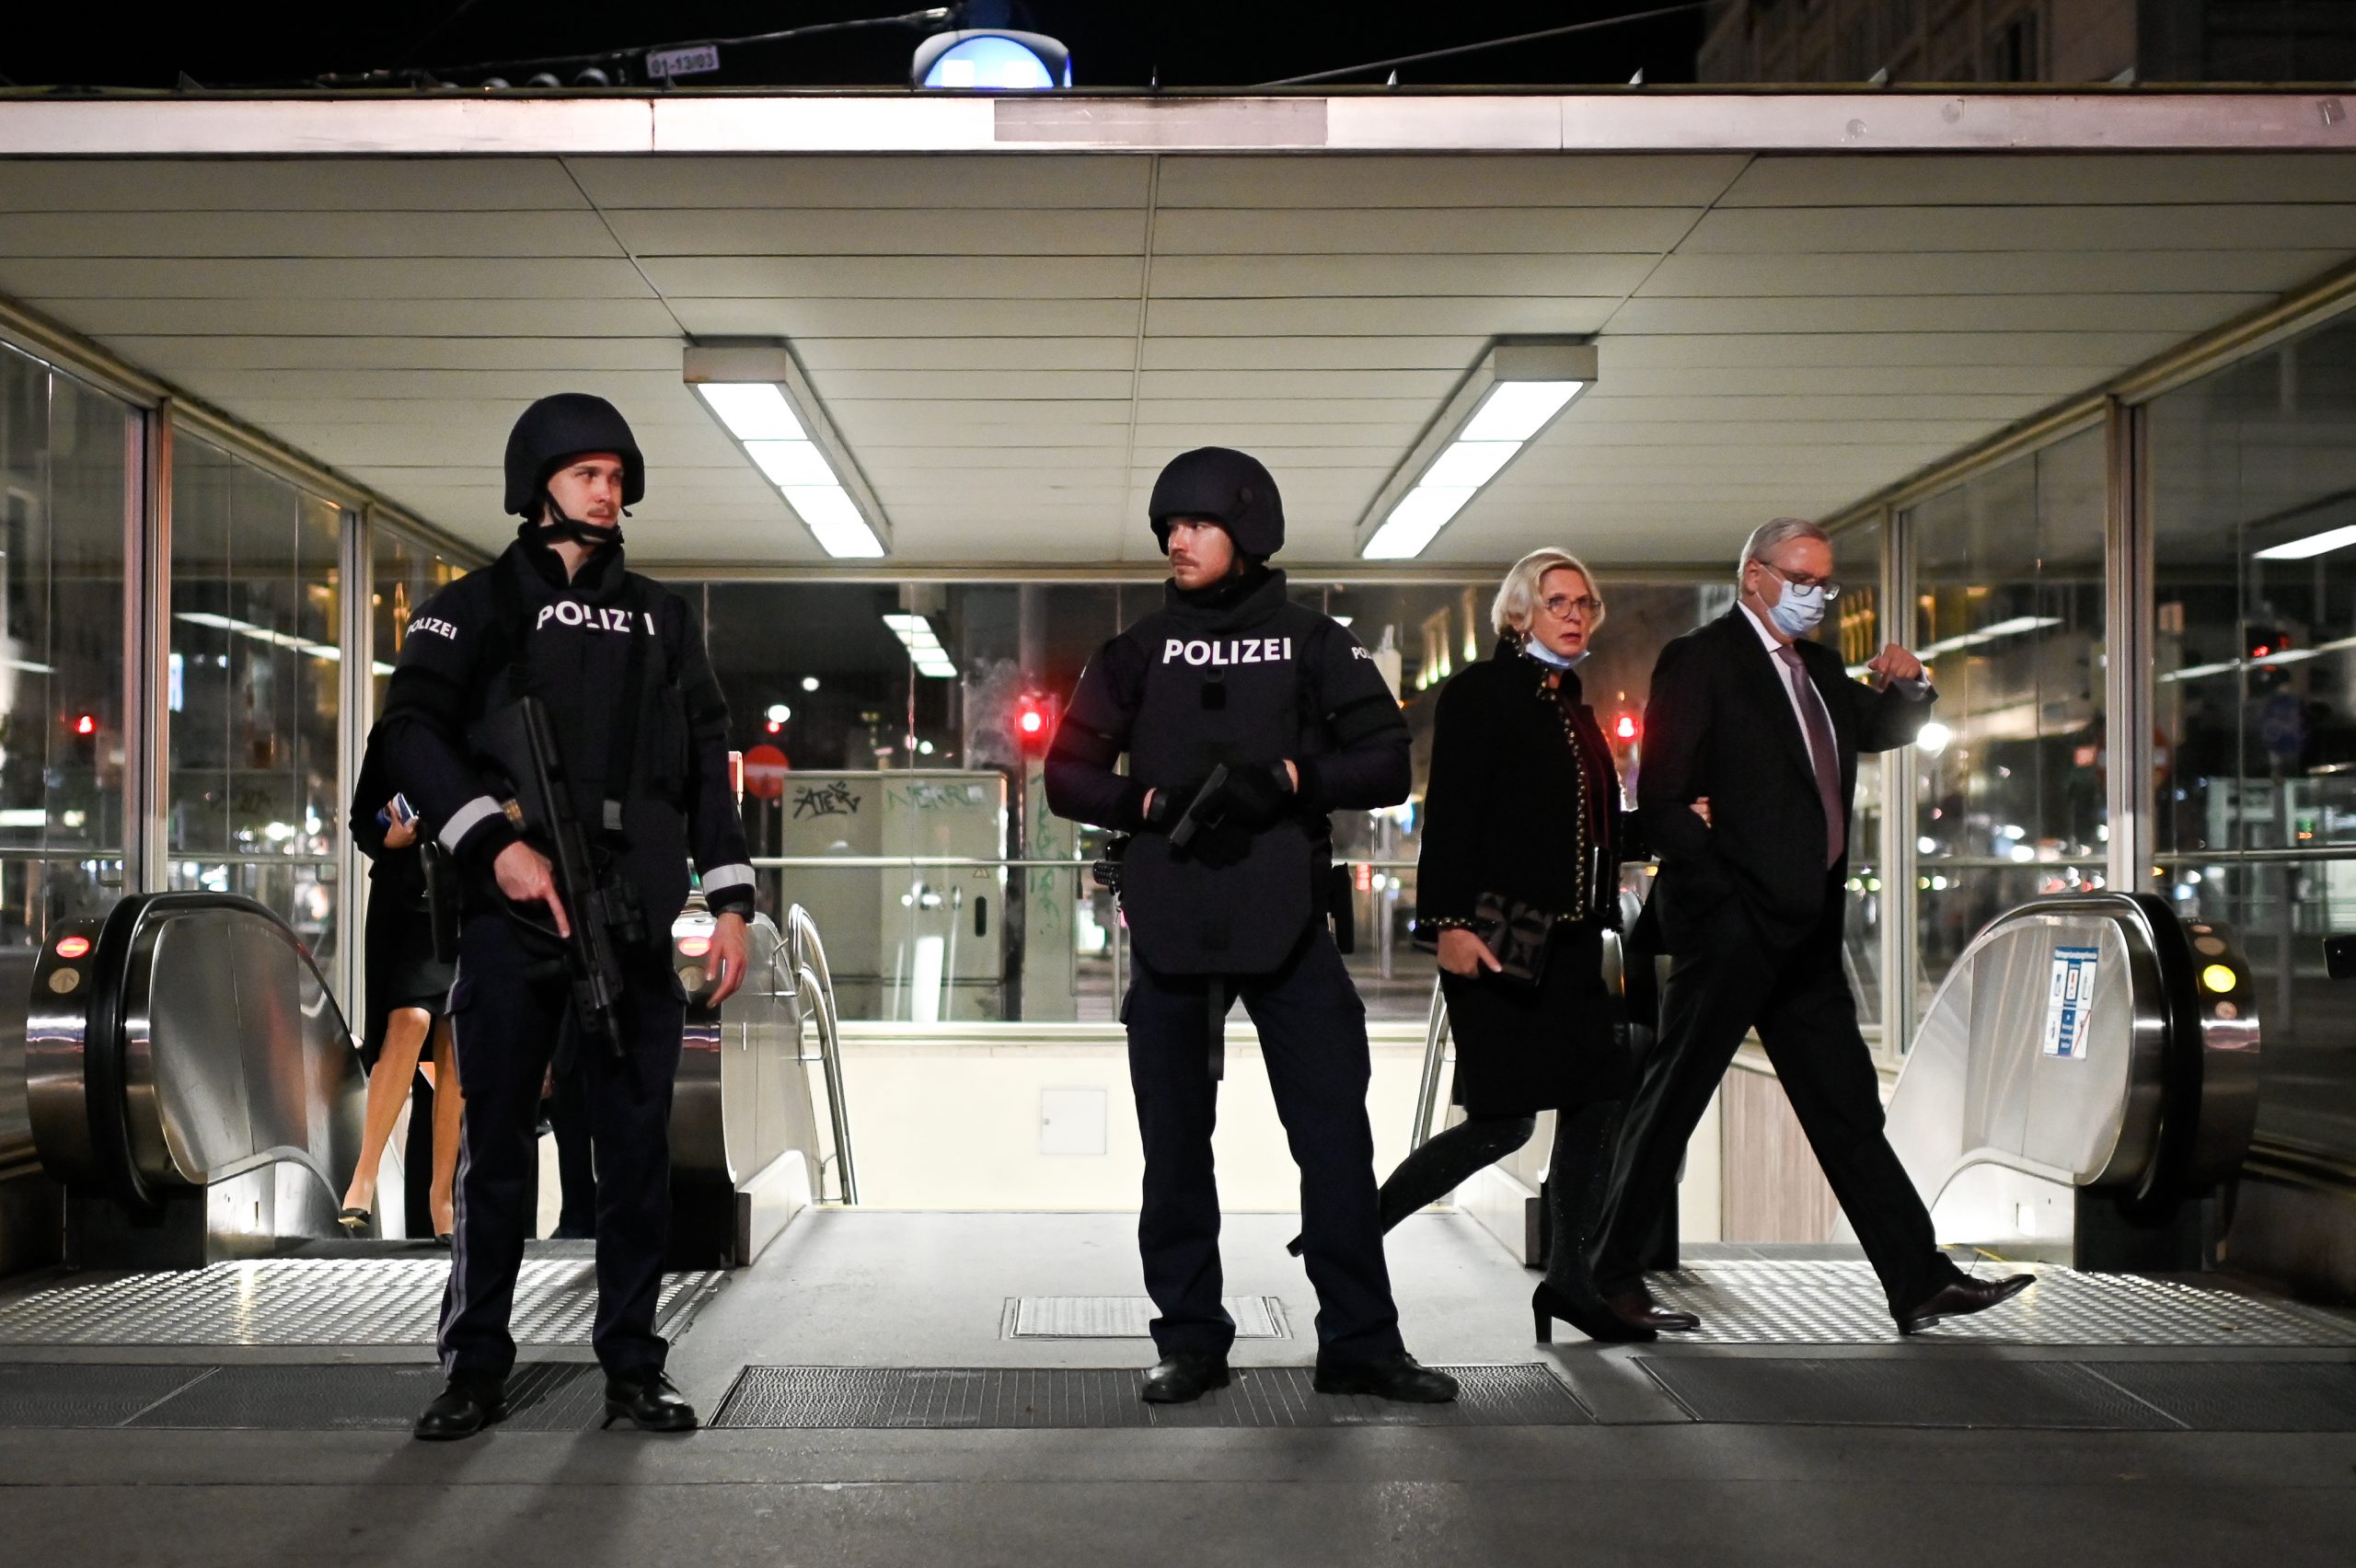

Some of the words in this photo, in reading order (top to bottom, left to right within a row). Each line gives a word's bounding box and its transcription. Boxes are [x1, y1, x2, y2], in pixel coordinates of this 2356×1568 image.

[405, 617, 457, 640] POLIZEI
[537, 600, 655, 636] POLIZI
[1162, 637, 1291, 666] POLIZEI
